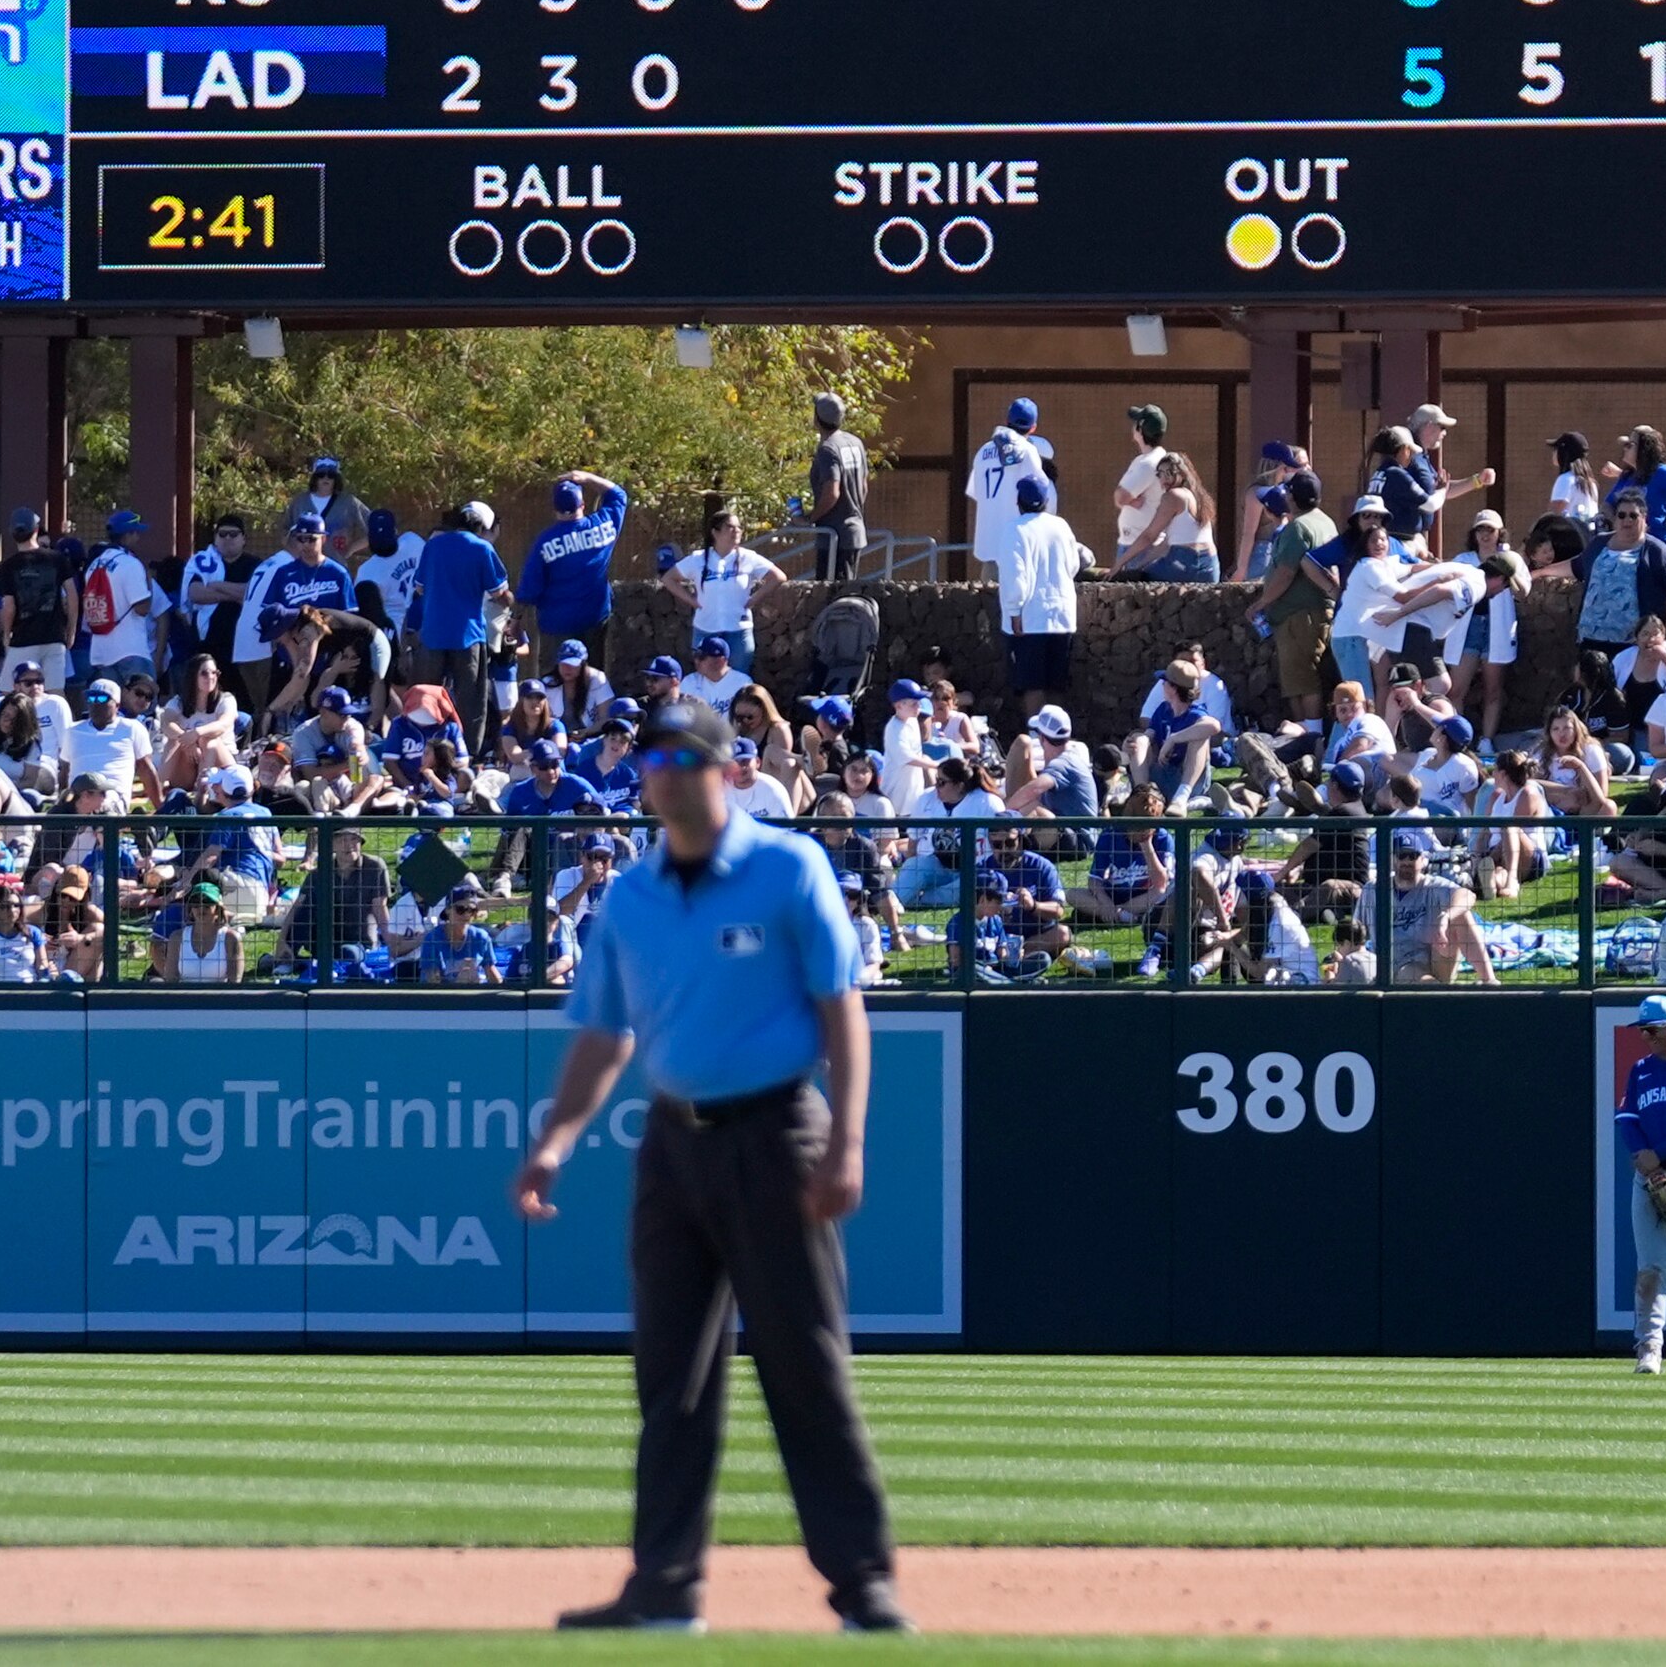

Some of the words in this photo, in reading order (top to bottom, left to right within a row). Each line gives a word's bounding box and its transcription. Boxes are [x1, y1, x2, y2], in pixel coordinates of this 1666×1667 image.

[147, 49, 305, 109] LAD
[441, 55, 482, 111] 2
[539, 54, 579, 111] 3
[632, 53, 679, 110] 0
[1401, 45, 1445, 107] 5
[1517, 42, 1565, 105] 5
[473, 163, 622, 208] BALL
[833, 160, 1039, 206] STRIKE
[1224, 157, 1349, 203] OUT
[147, 193, 275, 248] 2:41
[984, 467, 1004, 498] 17
[284, 580, 340, 605] Dodgers
[1175, 1051, 1376, 1134] 380
[113, 1213, 501, 1267] ARIZONA
